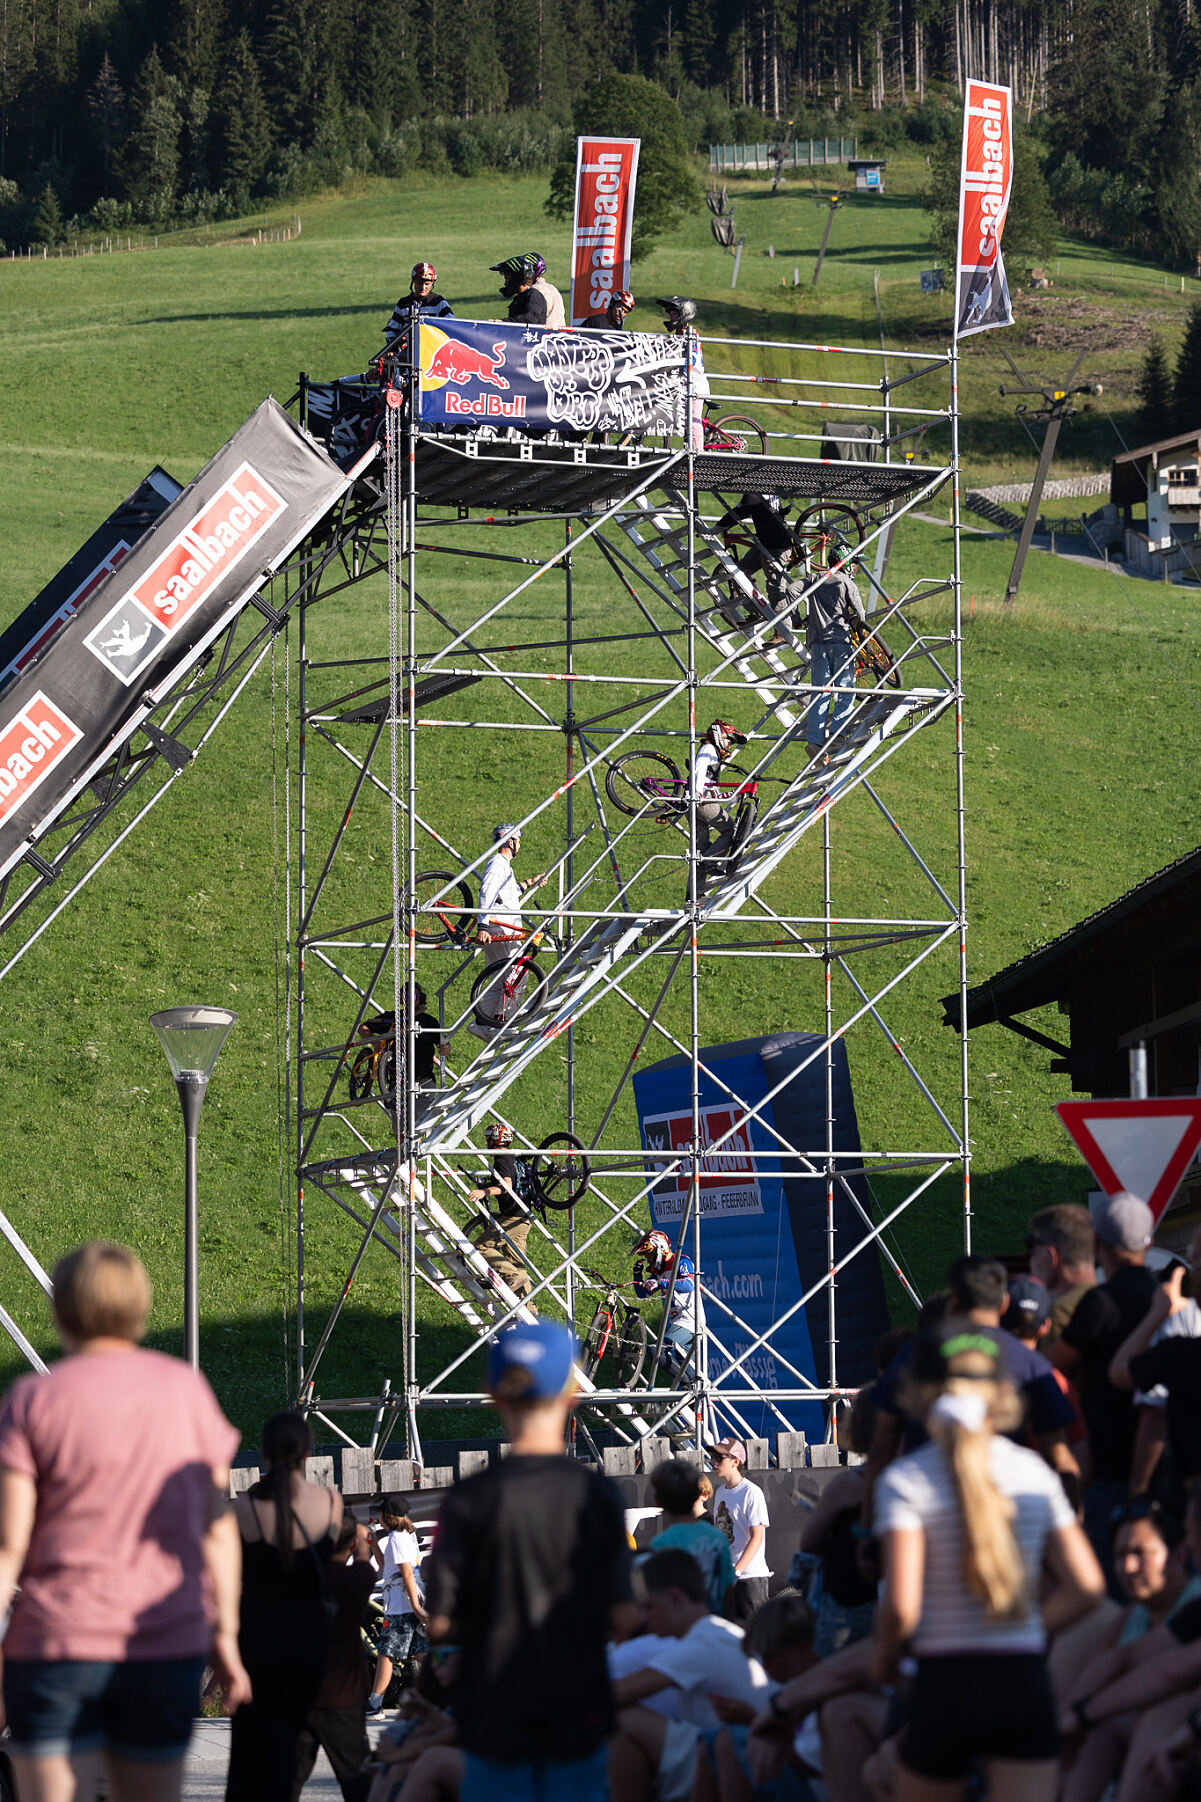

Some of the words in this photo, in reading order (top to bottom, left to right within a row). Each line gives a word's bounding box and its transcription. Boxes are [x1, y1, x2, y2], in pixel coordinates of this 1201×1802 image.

[575, 153, 622, 310] saalbach
[965, 98, 1003, 257] saalbach
[446, 392, 485, 415] Red
[487, 395, 526, 417] Bull
[153, 480, 267, 615] saalbach
[0, 711, 62, 804] bach
